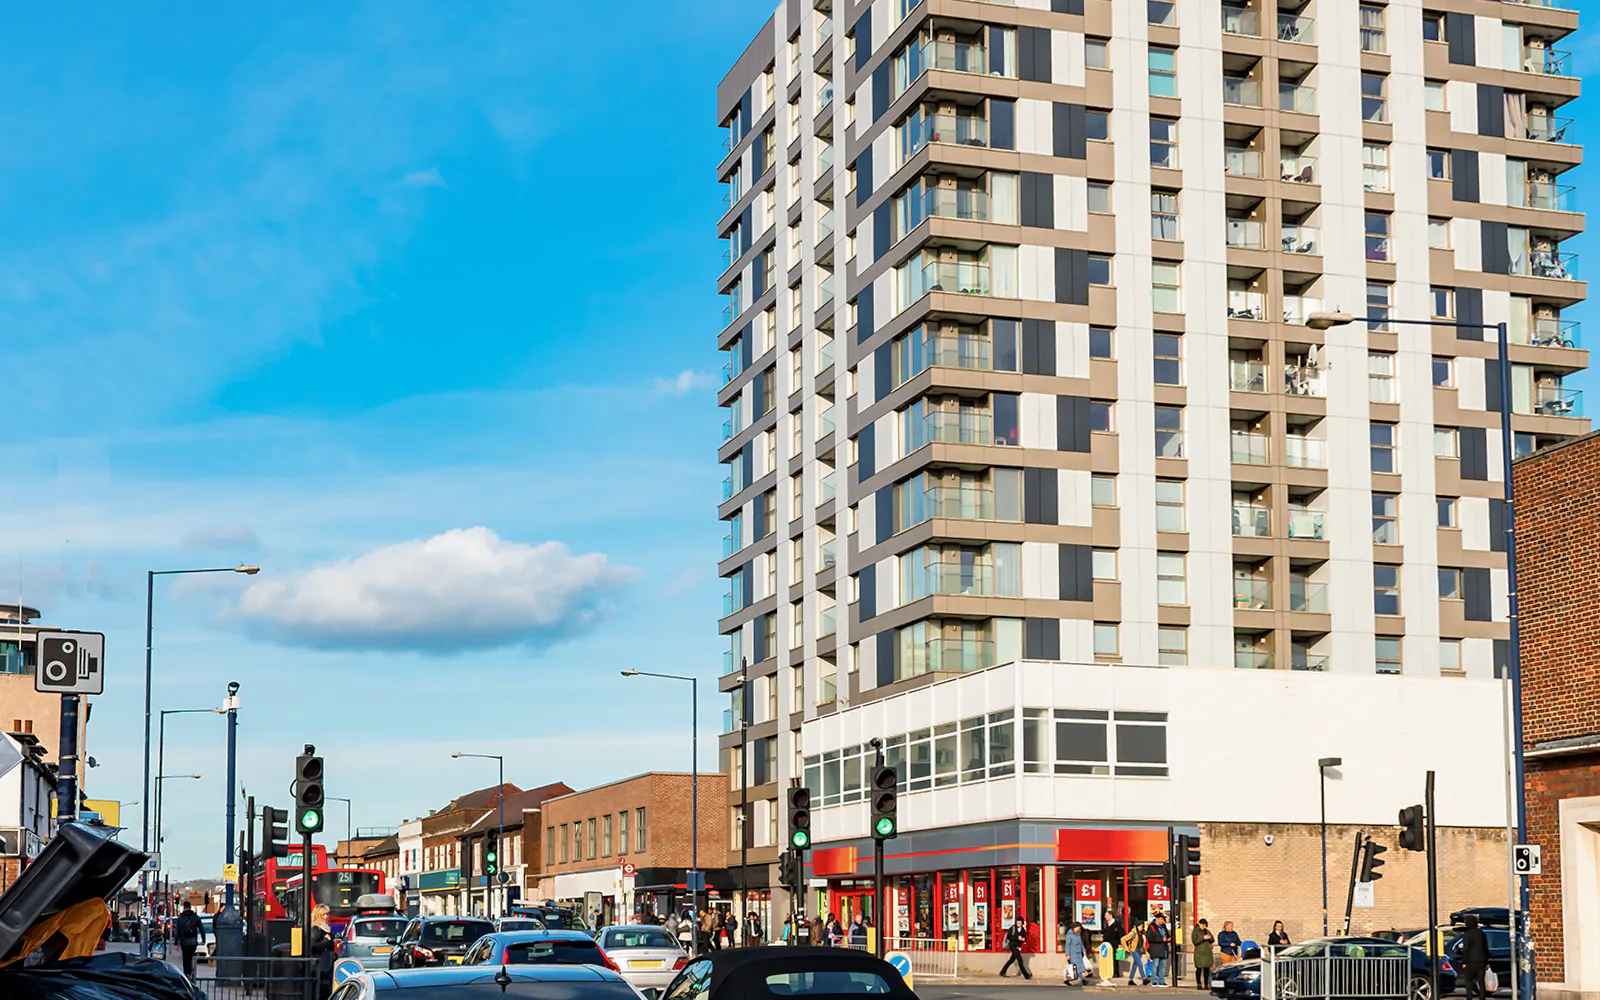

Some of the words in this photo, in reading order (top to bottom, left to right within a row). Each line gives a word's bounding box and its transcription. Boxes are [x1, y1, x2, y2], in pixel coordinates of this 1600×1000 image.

[339, 872, 352, 882] 251
[949, 887, 957, 899] £1
[977, 886, 985, 898] £1
[1004, 884, 1012, 896] £1
[1081, 884, 1096, 896] £1
[1153, 884, 1168, 896] £1
